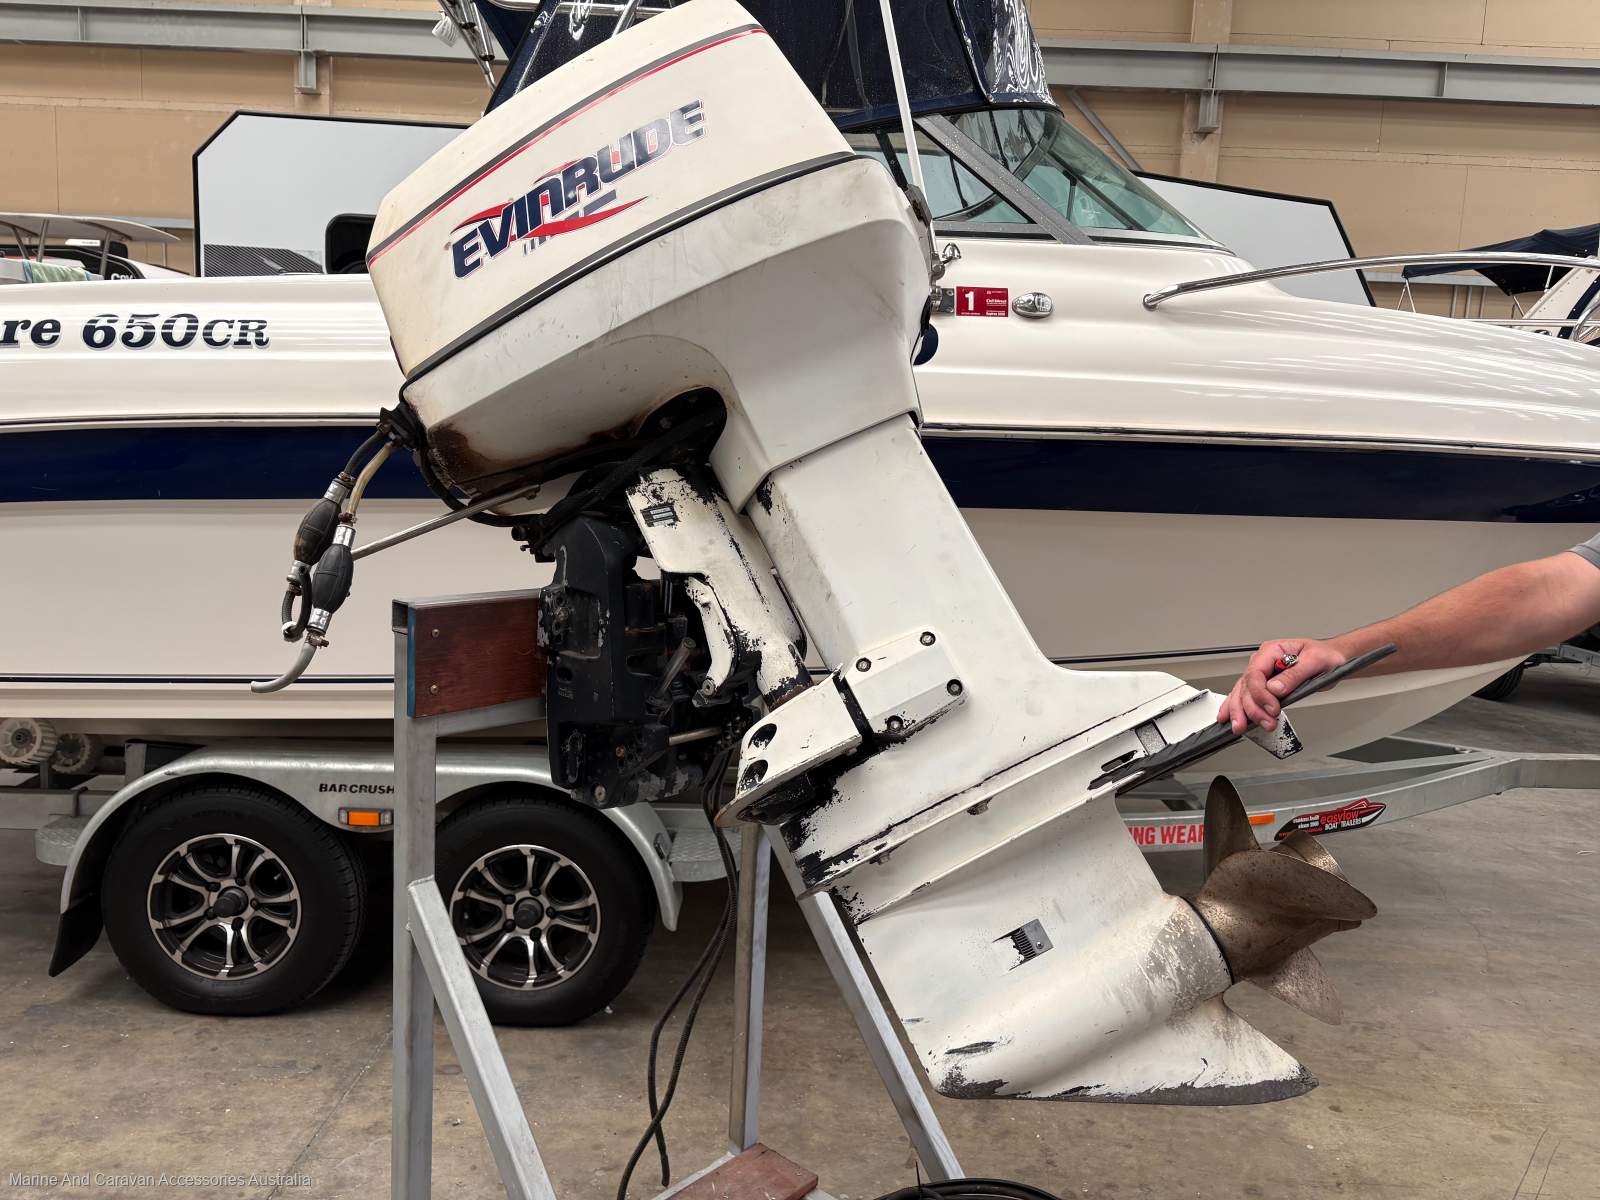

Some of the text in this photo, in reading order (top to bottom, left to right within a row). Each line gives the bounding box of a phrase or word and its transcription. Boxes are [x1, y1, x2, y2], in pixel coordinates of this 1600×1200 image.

[452, 99, 707, 279] EVINRUDE
[965, 291, 975, 311] 1
[0, 313, 271, 350] re 650CR
[319, 784, 394, 794] BARCRUSH
[1325, 821, 1339, 831] BOAT
[1340, 818, 1361, 828] TRAILERS
